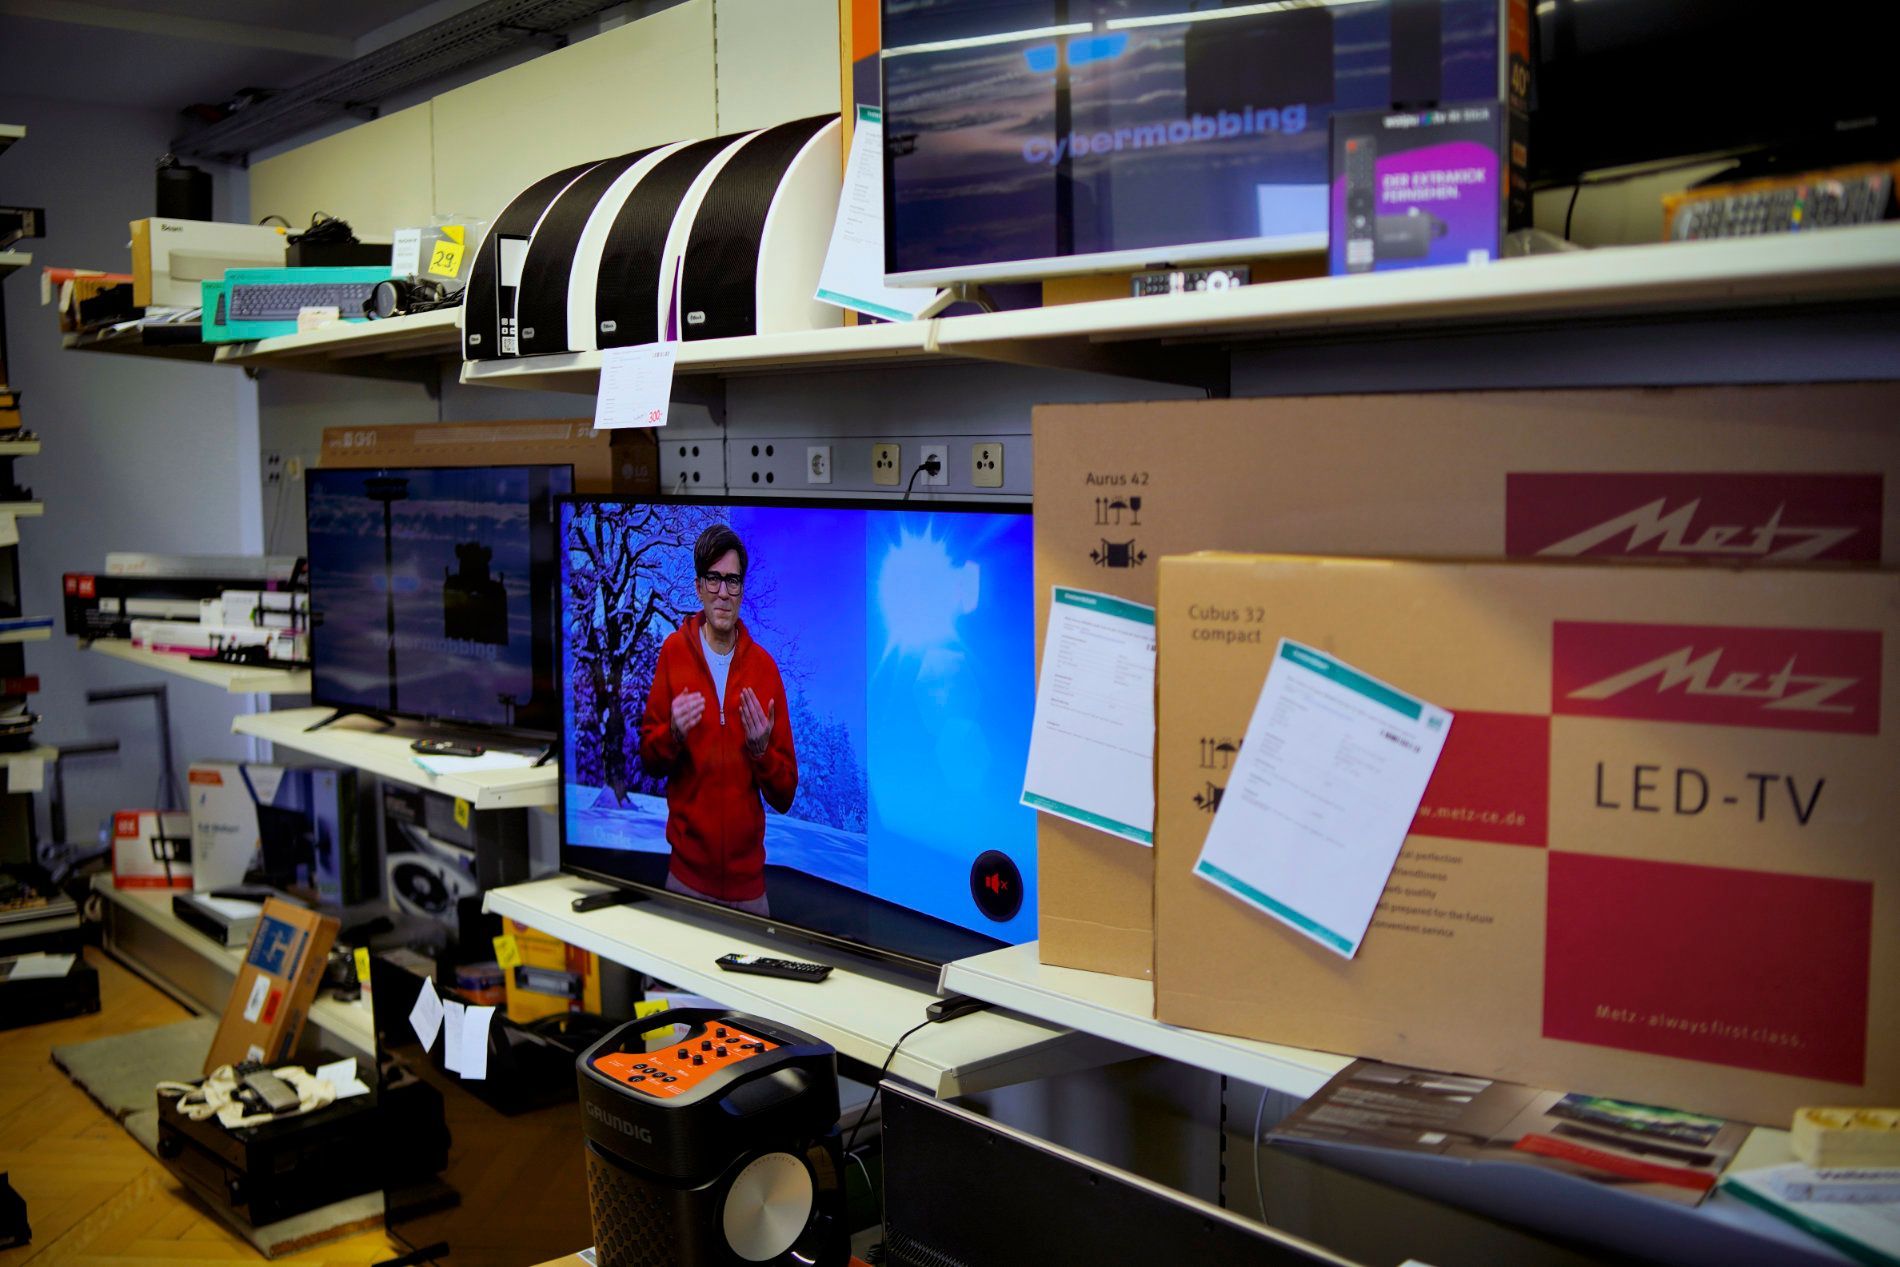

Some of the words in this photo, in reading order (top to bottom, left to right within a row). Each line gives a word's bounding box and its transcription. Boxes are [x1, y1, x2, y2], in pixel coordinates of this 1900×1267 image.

[1022, 103, 1307, 165] Cybermobbing
[1086, 472, 1127, 486] Aurus
[1131, 472, 1149, 485] 42
[1534, 497, 1859, 560] Metz
[1188, 603, 1239, 621] Cubus
[1245, 607, 1265, 623] 32
[1192, 628, 1261, 644] compact
[1565, 645, 1862, 713] Metz
[1594, 761, 1826, 826] LED-TV
[1419, 805, 1526, 826] w.metz-ce.de
[1415, 852, 1463, 864] perfection
[1404, 887, 1437, 900] quality
[1391, 904, 1432, 917] prepared
[1434, 907, 1448, 918] for
[1449, 909, 1464, 920] the
[1465, 910, 1494, 924] future
[1422, 924, 1455, 938] service
[1595, 1004, 1637, 1023] Metz
[1648, 1013, 1709, 1034] always
[1711, 1020, 1750, 1039] first
[586, 1101, 653, 1144] GRUNDIG
